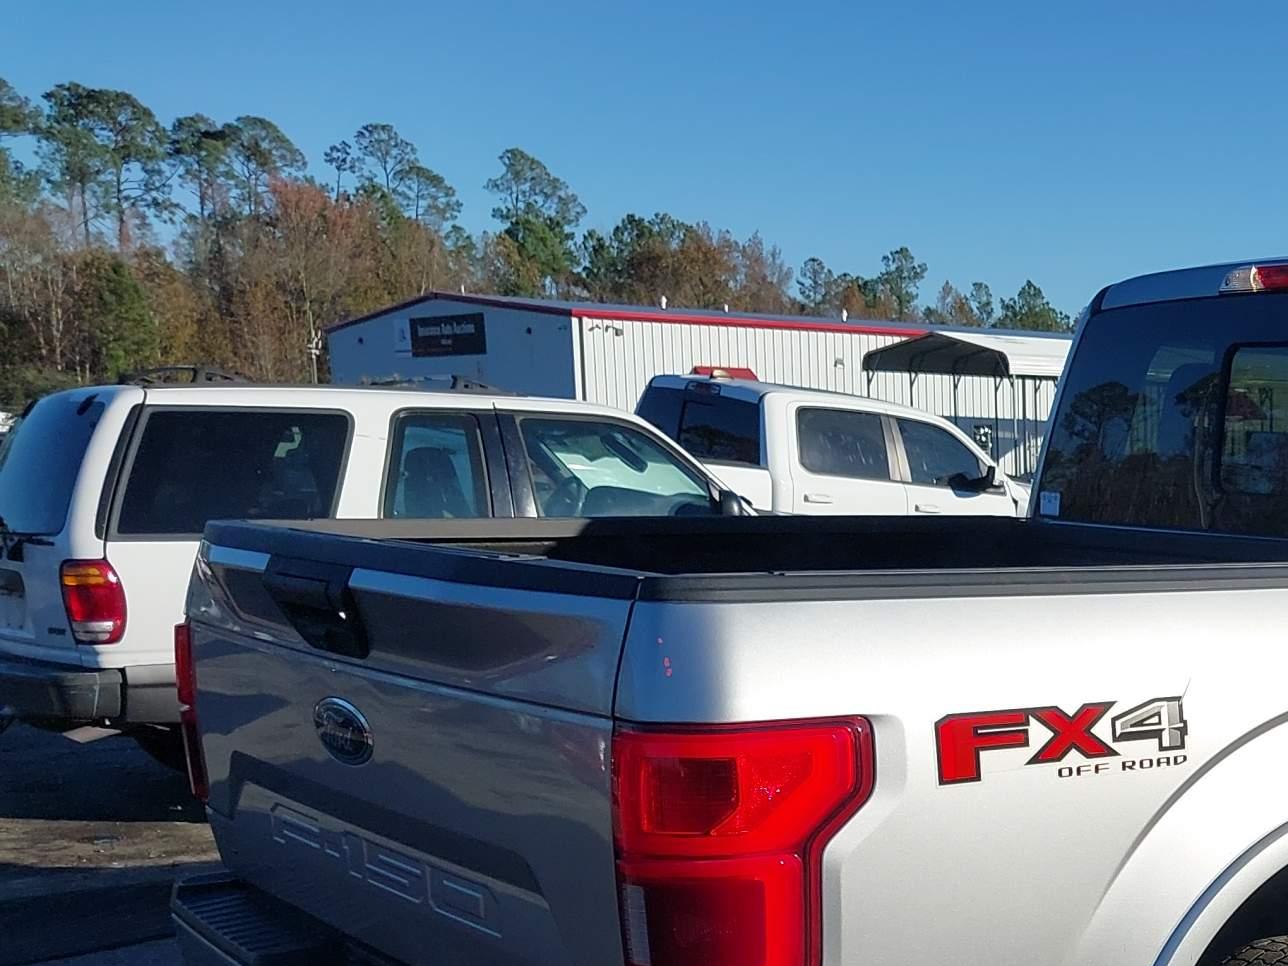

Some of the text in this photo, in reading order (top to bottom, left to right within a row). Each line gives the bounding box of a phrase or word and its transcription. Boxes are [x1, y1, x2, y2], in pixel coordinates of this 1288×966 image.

[935, 696, 1187, 785] FX4
[1057, 754, 1187, 778] OFF ROAD
[270, 803, 503, 940] F-150
